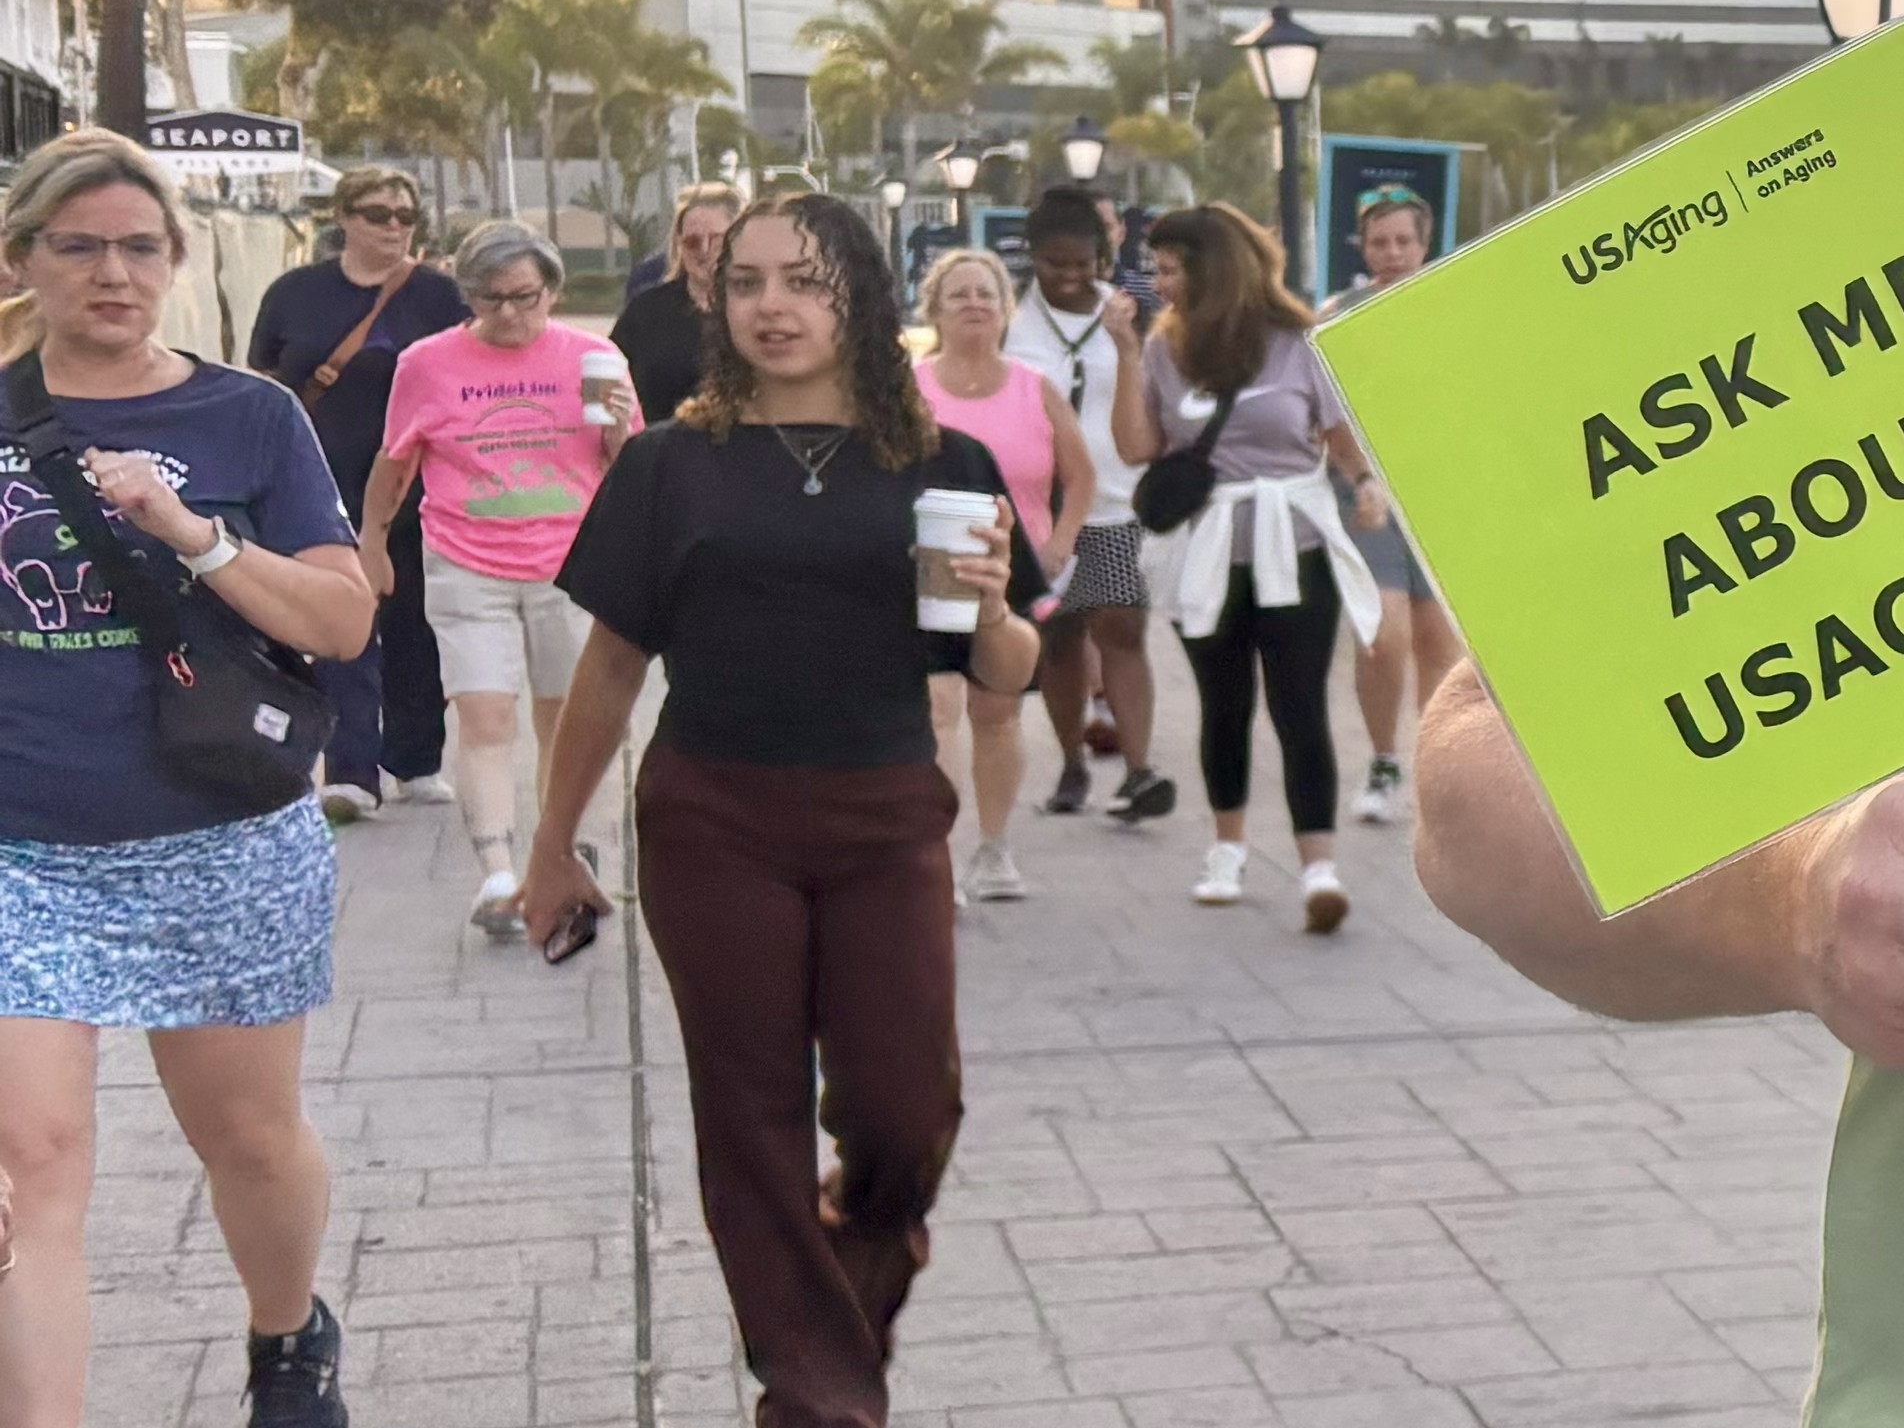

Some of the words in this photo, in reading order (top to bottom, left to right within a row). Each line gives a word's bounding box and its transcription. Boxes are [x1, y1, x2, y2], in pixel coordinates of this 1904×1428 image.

[150, 127, 293, 148] SEAPORT
[1747, 128, 1825, 178] Answers
[1758, 179, 1782, 199] on
[1784, 149, 1837, 187] Aging
[1562, 189, 1729, 285] USAging
[1583, 333, 1790, 500] ASK
